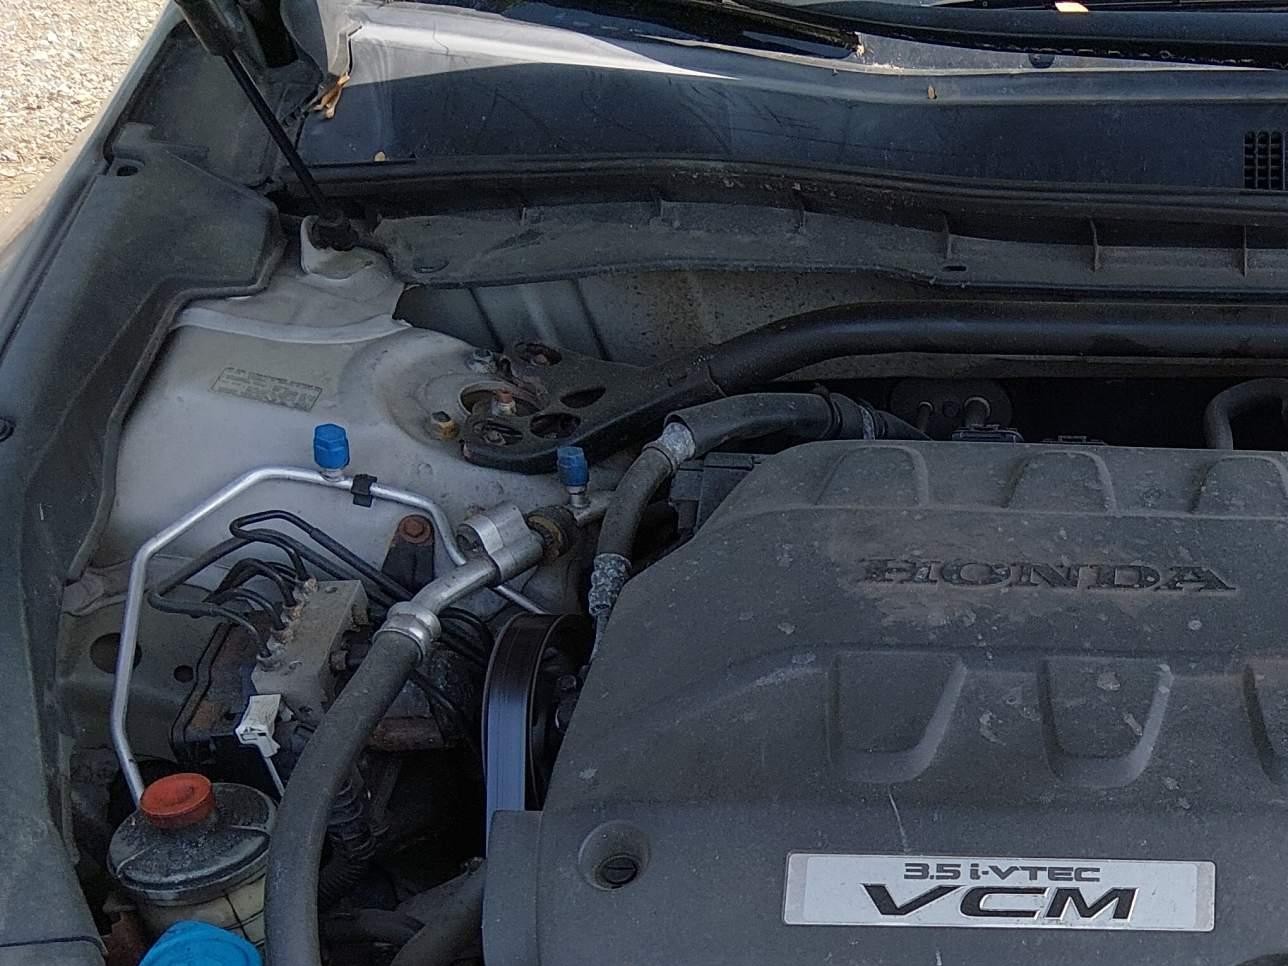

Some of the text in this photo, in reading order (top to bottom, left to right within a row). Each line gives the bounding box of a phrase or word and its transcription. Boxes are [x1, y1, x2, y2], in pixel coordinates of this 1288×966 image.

[860, 558, 1237, 591] HONDA
[903, 862, 1101, 882] 3.5 i-VTEC
[862, 883, 1138, 921] VCM
